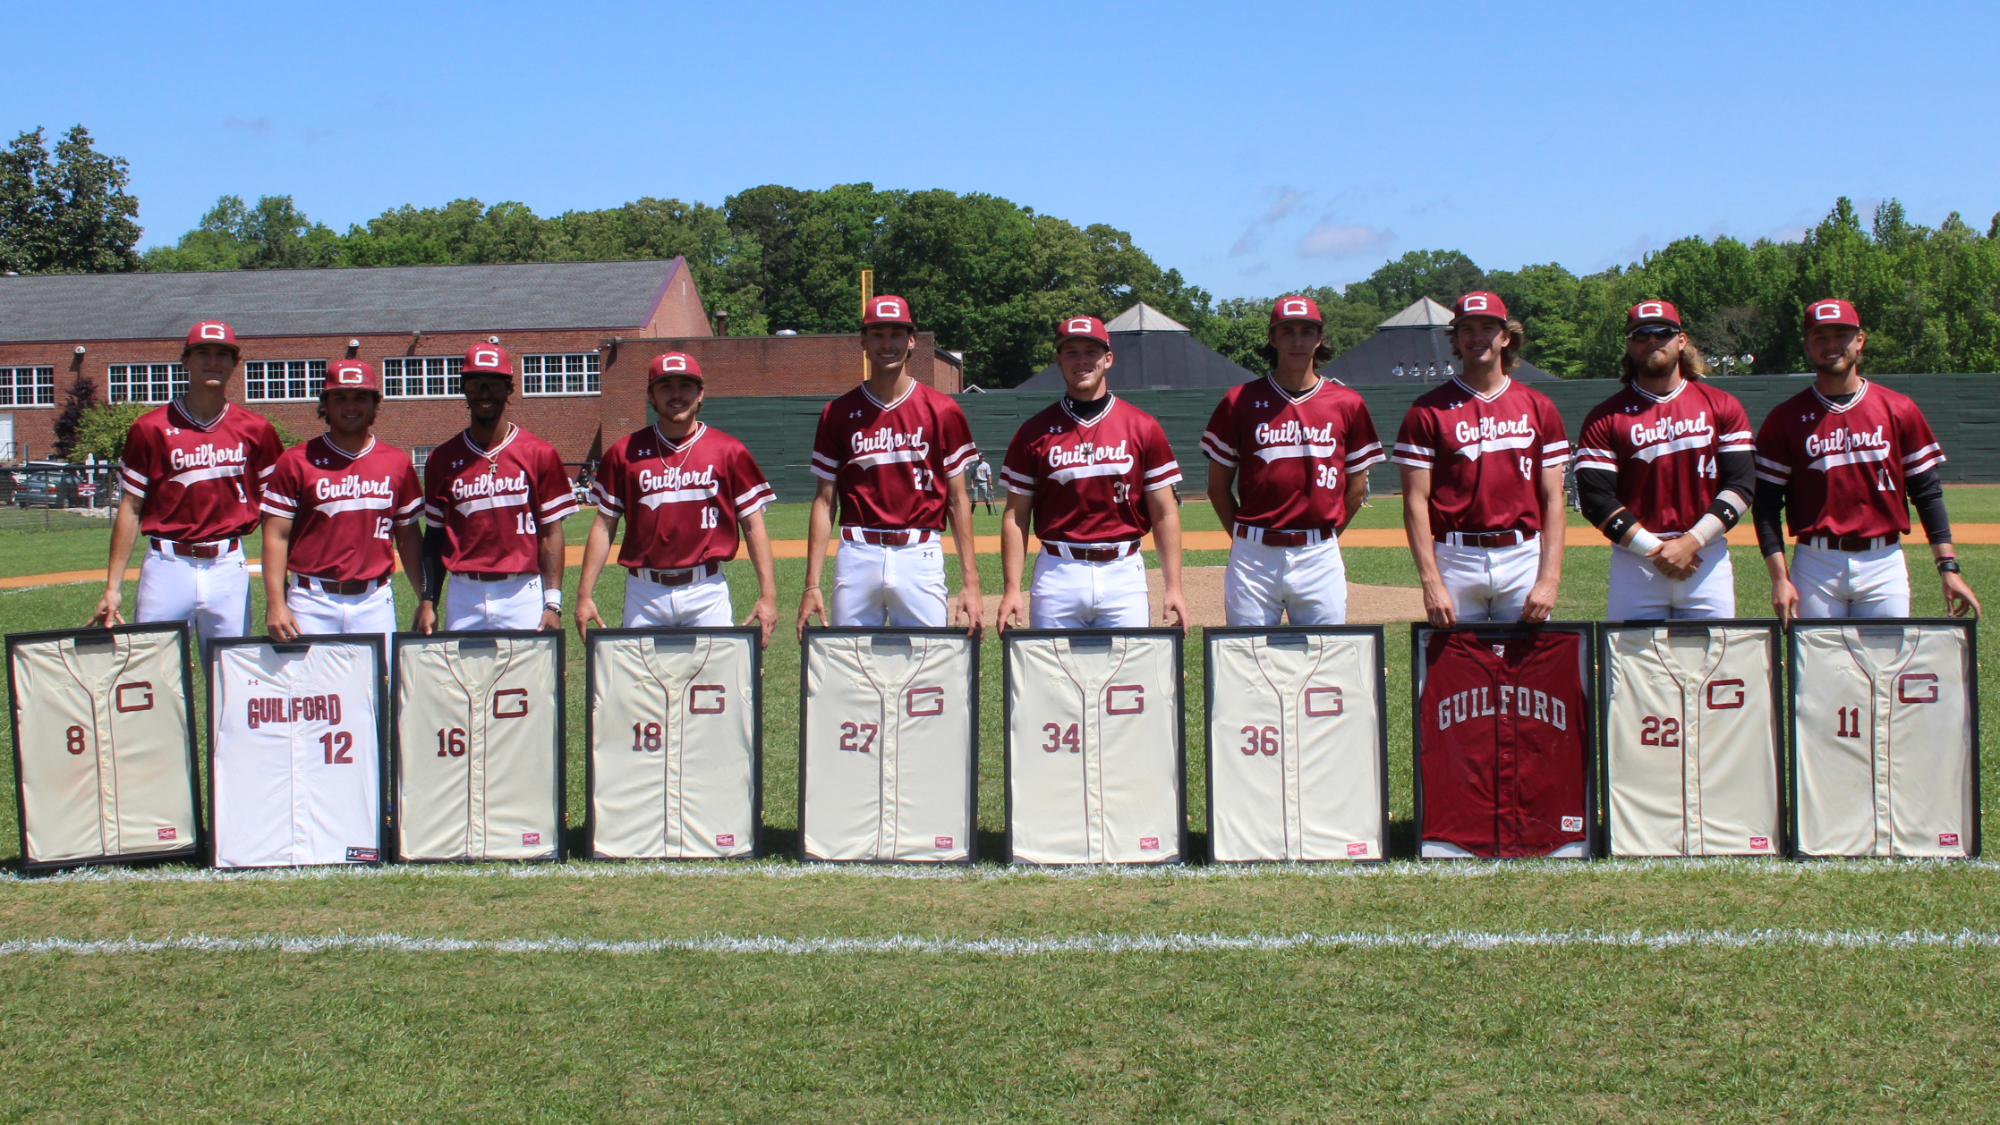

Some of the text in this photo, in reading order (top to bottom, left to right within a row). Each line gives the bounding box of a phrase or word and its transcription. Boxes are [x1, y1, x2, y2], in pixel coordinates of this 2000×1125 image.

[877, 302, 900, 317] G
[1283, 301, 1308, 316] G
[1464, 296, 1487, 311] G
[1638, 304, 1662, 318] G
[1816, 304, 1840, 320] G
[201, 324, 225, 340] G
[1068, 319, 1092, 334] G
[475, 351, 498, 367] G
[662, 356, 687, 371] G
[339, 368, 363, 384] G
[851, 427, 929, 454] Guilford
[1255, 422, 1336, 445] Guilford
[1455, 414, 1535, 443] Guilford
[1630, 411, 1714, 446] Guilford
[1805, 425, 1890, 457] Guilford
[171, 442, 247, 470] Guilford
[1698, 454, 1717, 479] 44
[316, 475, 393, 500] Guilford
[452, 470, 529, 500] Guilford
[638, 465, 719, 492] Guilford
[913, 467, 934, 491] 27
[1317, 464, 1338, 489] 36
[373, 516, 393, 540] 12
[516, 511, 537, 535] 16
[700, 506, 719, 529] 18
[116, 681, 154, 713] G
[689, 685, 725, 714] G
[906, 686, 944, 717] G
[1106, 685, 1144, 714] G
[1304, 687, 1343, 717] G
[1707, 679, 1744, 709] G
[1899, 673, 1938, 703] G
[248, 693, 341, 729] GUILFORD
[493, 688, 528, 719] G
[1438, 685, 1566, 731] GUILFORD
[633, 722, 661, 751] 18
[1641, 716, 1680, 747] 22
[1838, 706, 1860, 738] 11
[66, 725, 85, 755] 8
[319, 731, 353, 764] 12
[438, 728, 466, 757] 16
[840, 722, 878, 752] 27
[1042, 723, 1080, 753] 34
[1241, 726, 1279, 756] 36
